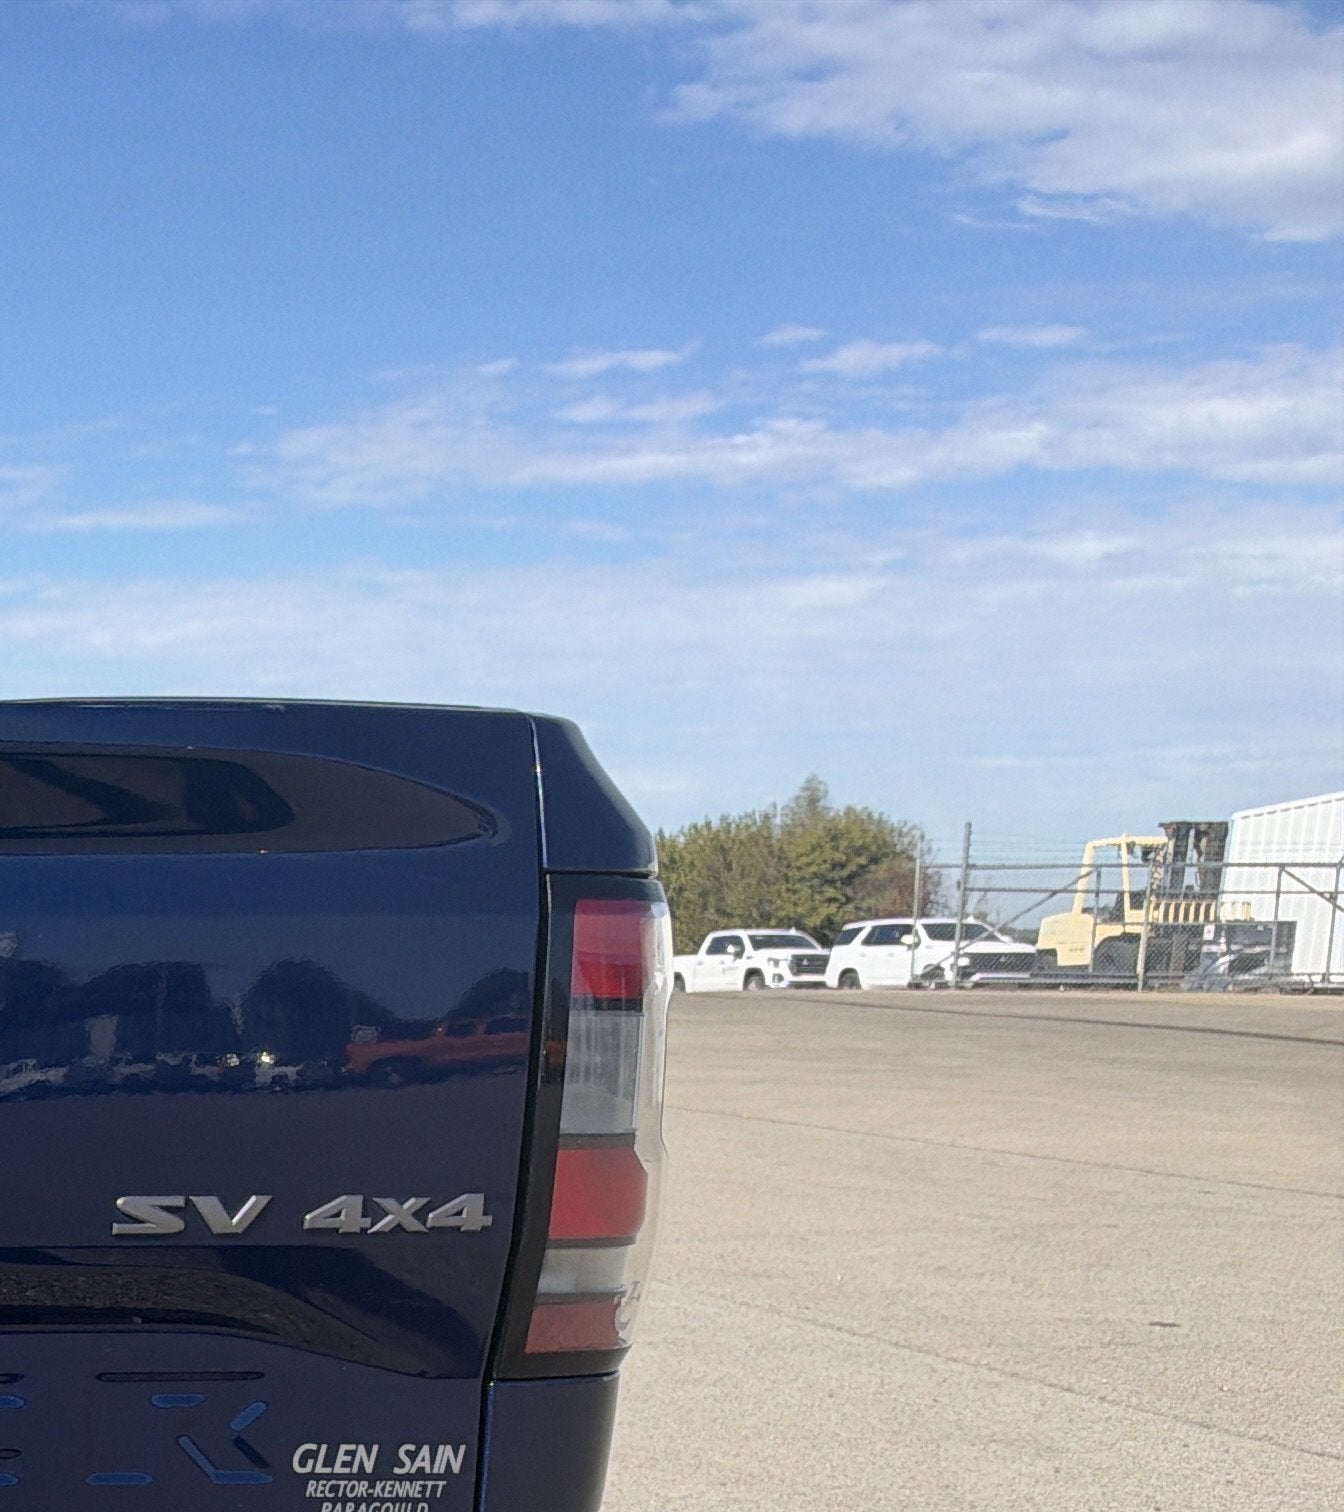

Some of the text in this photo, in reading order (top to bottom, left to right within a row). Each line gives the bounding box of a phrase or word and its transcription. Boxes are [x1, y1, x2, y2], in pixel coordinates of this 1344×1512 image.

[112, 1194, 272, 1235] SV
[292, 1443, 466, 1475] GLEN SAIN
[305, 1480, 447, 1498] RECTOR-KENNETT
